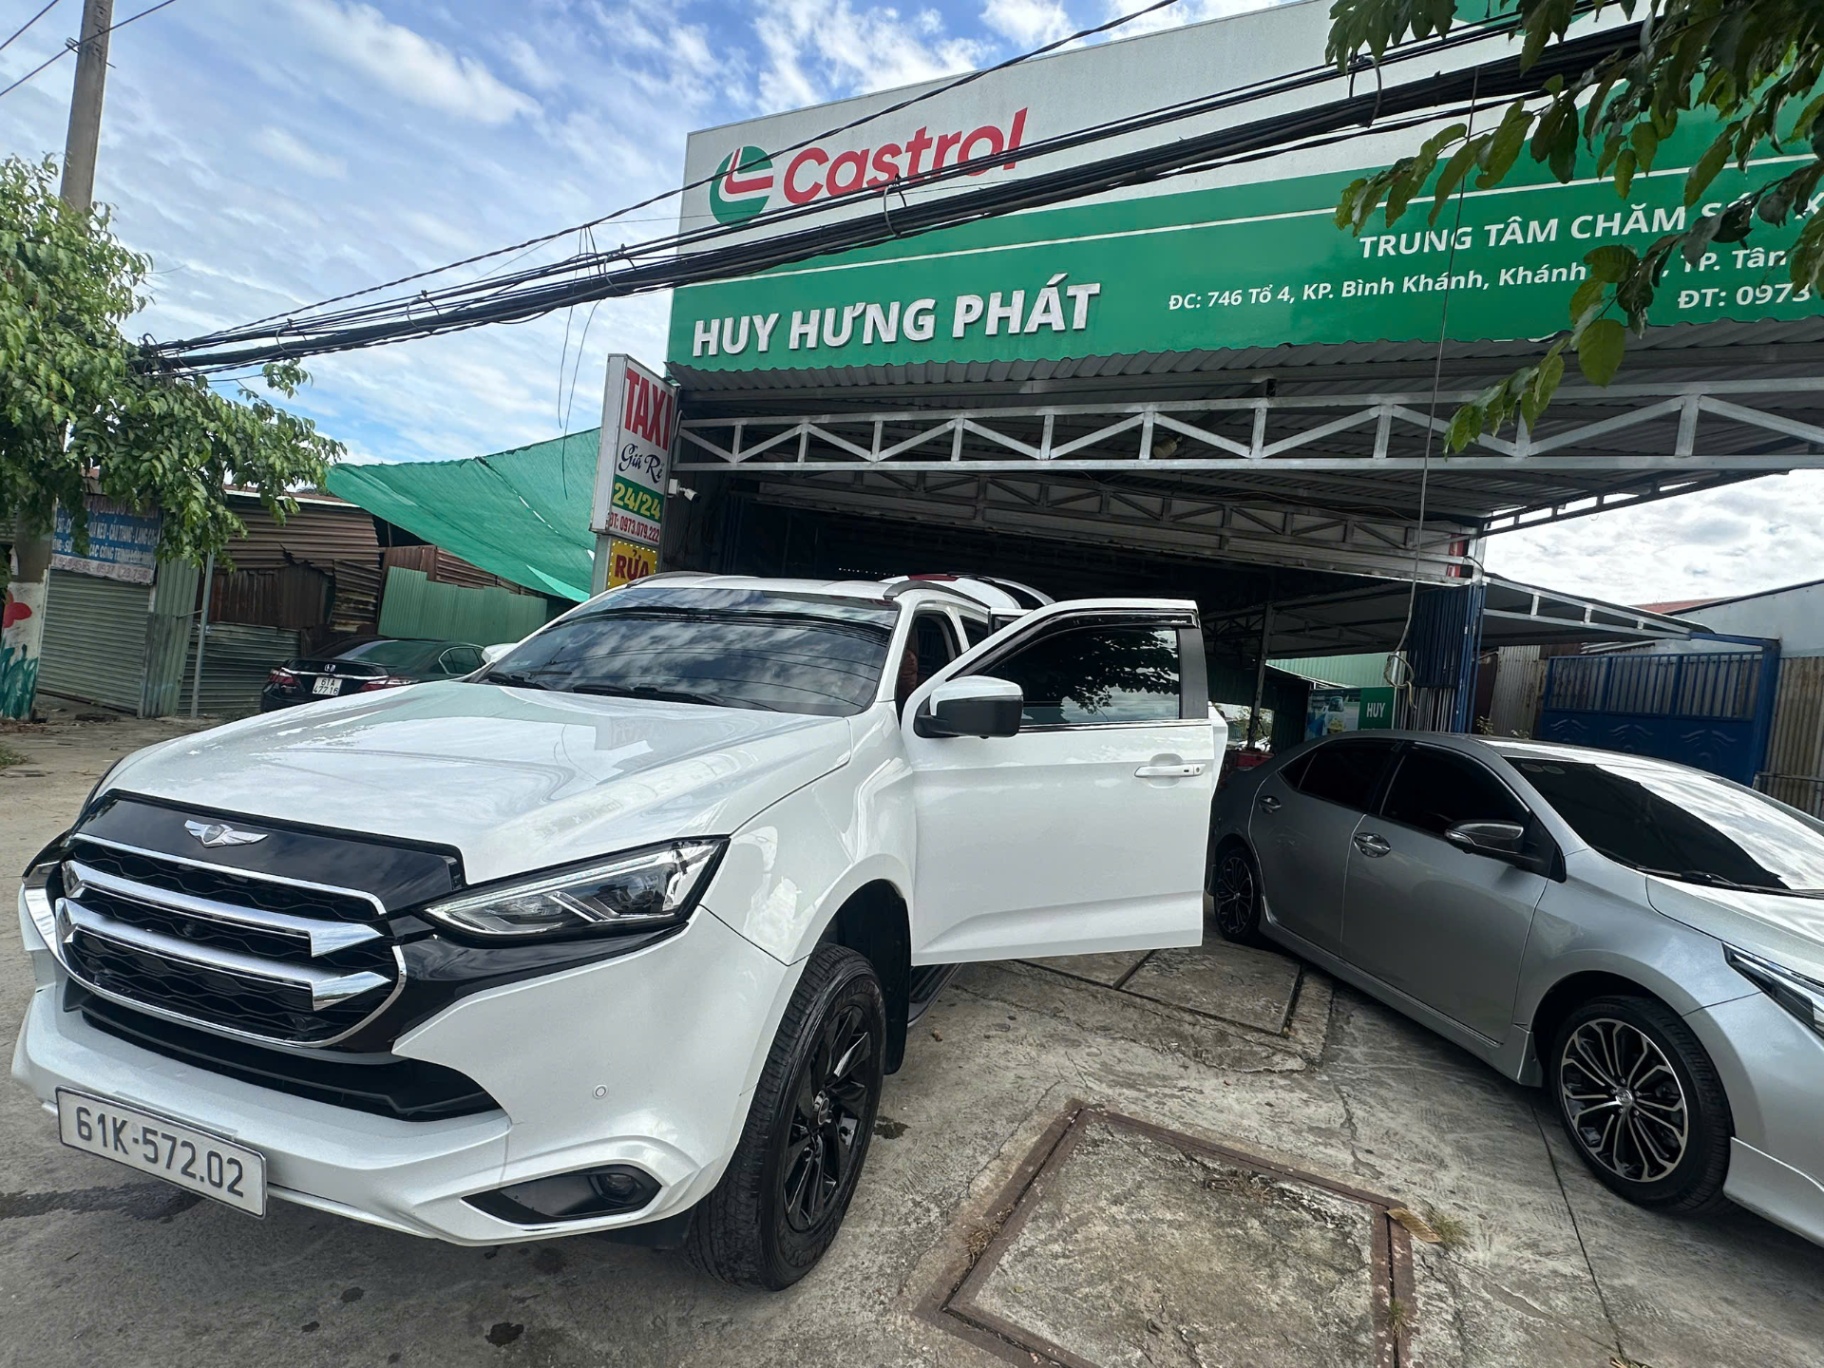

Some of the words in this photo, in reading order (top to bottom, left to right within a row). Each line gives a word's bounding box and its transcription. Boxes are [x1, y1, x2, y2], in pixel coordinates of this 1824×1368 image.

[784, 107, 1028, 204] Castrol
[1359, 226, 1473, 259] TRUNG
[1484, 215, 1558, 247] TÂM
[1571, 202, 1686, 239] CHĂM
[1168, 293, 1201, 310] ĐC:
[1207, 289, 1242, 307] 746
[1249, 284, 1273, 304] Tổ
[1277, 286, 1295, 304] 4,
[1302, 282, 1334, 300] KP.
[1341, 278, 1394, 297] Bình
[1402, 269, 1490, 293] Khánh,
[1498, 262, 1586, 286] Khánh
[1732, 247, 1787, 269] Tân
[692, 313, 779, 357] HUY
[788, 298, 936, 351] HƯNG
[952, 272, 1101, 338] PHÁT
[1677, 288, 1727, 309] ĐT:
[624, 367, 673, 452] TAXI
[618, 443, 643, 472] Giá
[612, 482, 661, 521] 24/24
[620, 516, 659, 543] 0973.079.222
[615, 549, 650, 581] RỬA
[321, 678, 335, 686] 61A
[1366, 702, 1386, 718] HUY
[76, 1106, 244, 1198] 61K-572.02
